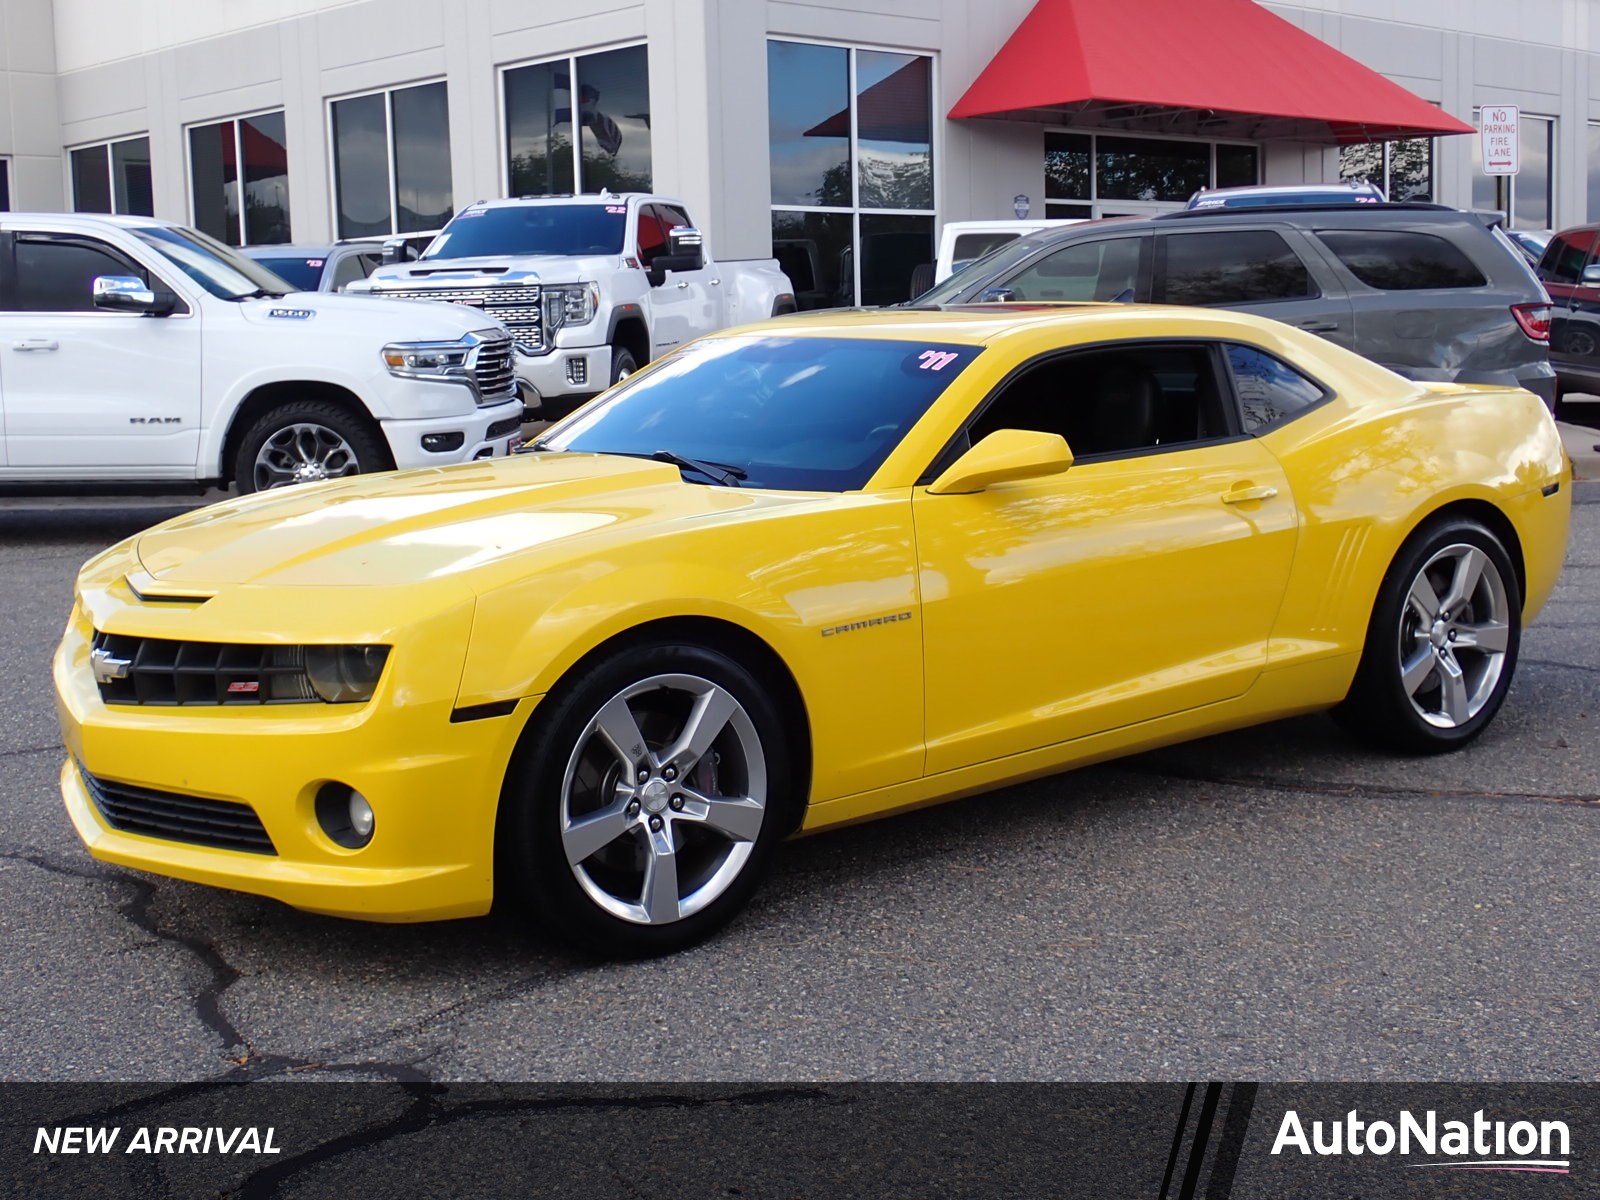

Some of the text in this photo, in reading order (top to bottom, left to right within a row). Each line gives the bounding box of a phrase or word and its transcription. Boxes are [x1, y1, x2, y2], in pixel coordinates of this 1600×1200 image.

[1492, 111, 1507, 122] NO
[1484, 124, 1516, 134] PARKING
[1490, 137, 1509, 146] FIRE
[1488, 148, 1512, 157] LANE
[821, 611, 912, 637] CAMARO
[227, 682, 259, 692] SS
